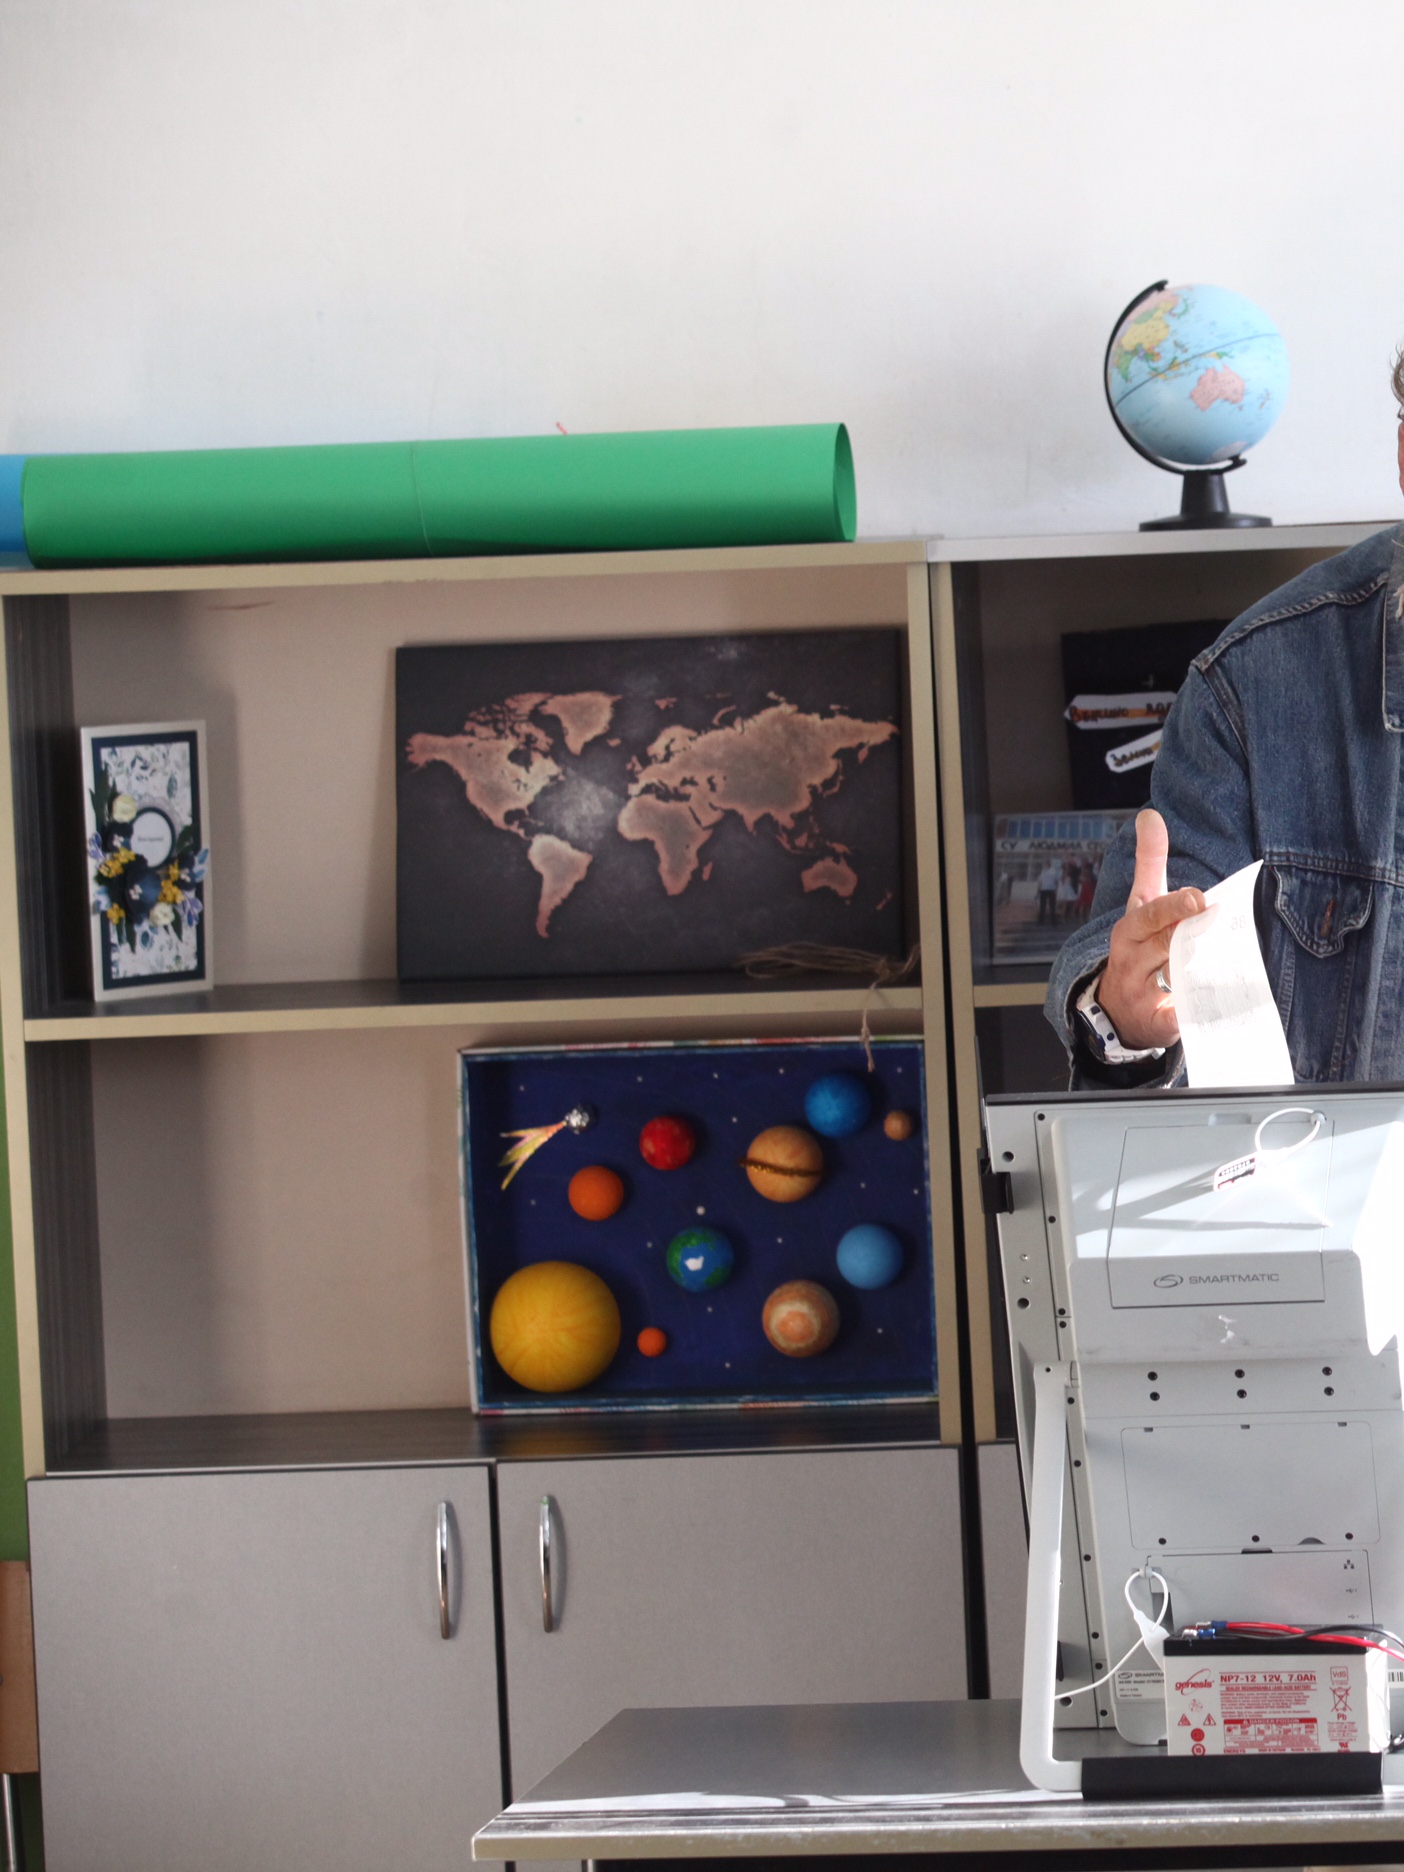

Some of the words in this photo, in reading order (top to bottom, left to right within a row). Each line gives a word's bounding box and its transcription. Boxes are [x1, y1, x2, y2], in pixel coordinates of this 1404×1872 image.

[1188, 1273, 1280, 1285] SMARTMATIC
[1220, 1674, 1257, 1683] NP7-12
[1262, 1674, 1283, 1684] 12V,
[1288, 1673, 1316, 1683] 7.0Ah
[1174, 1679, 1213, 1691] genesis
